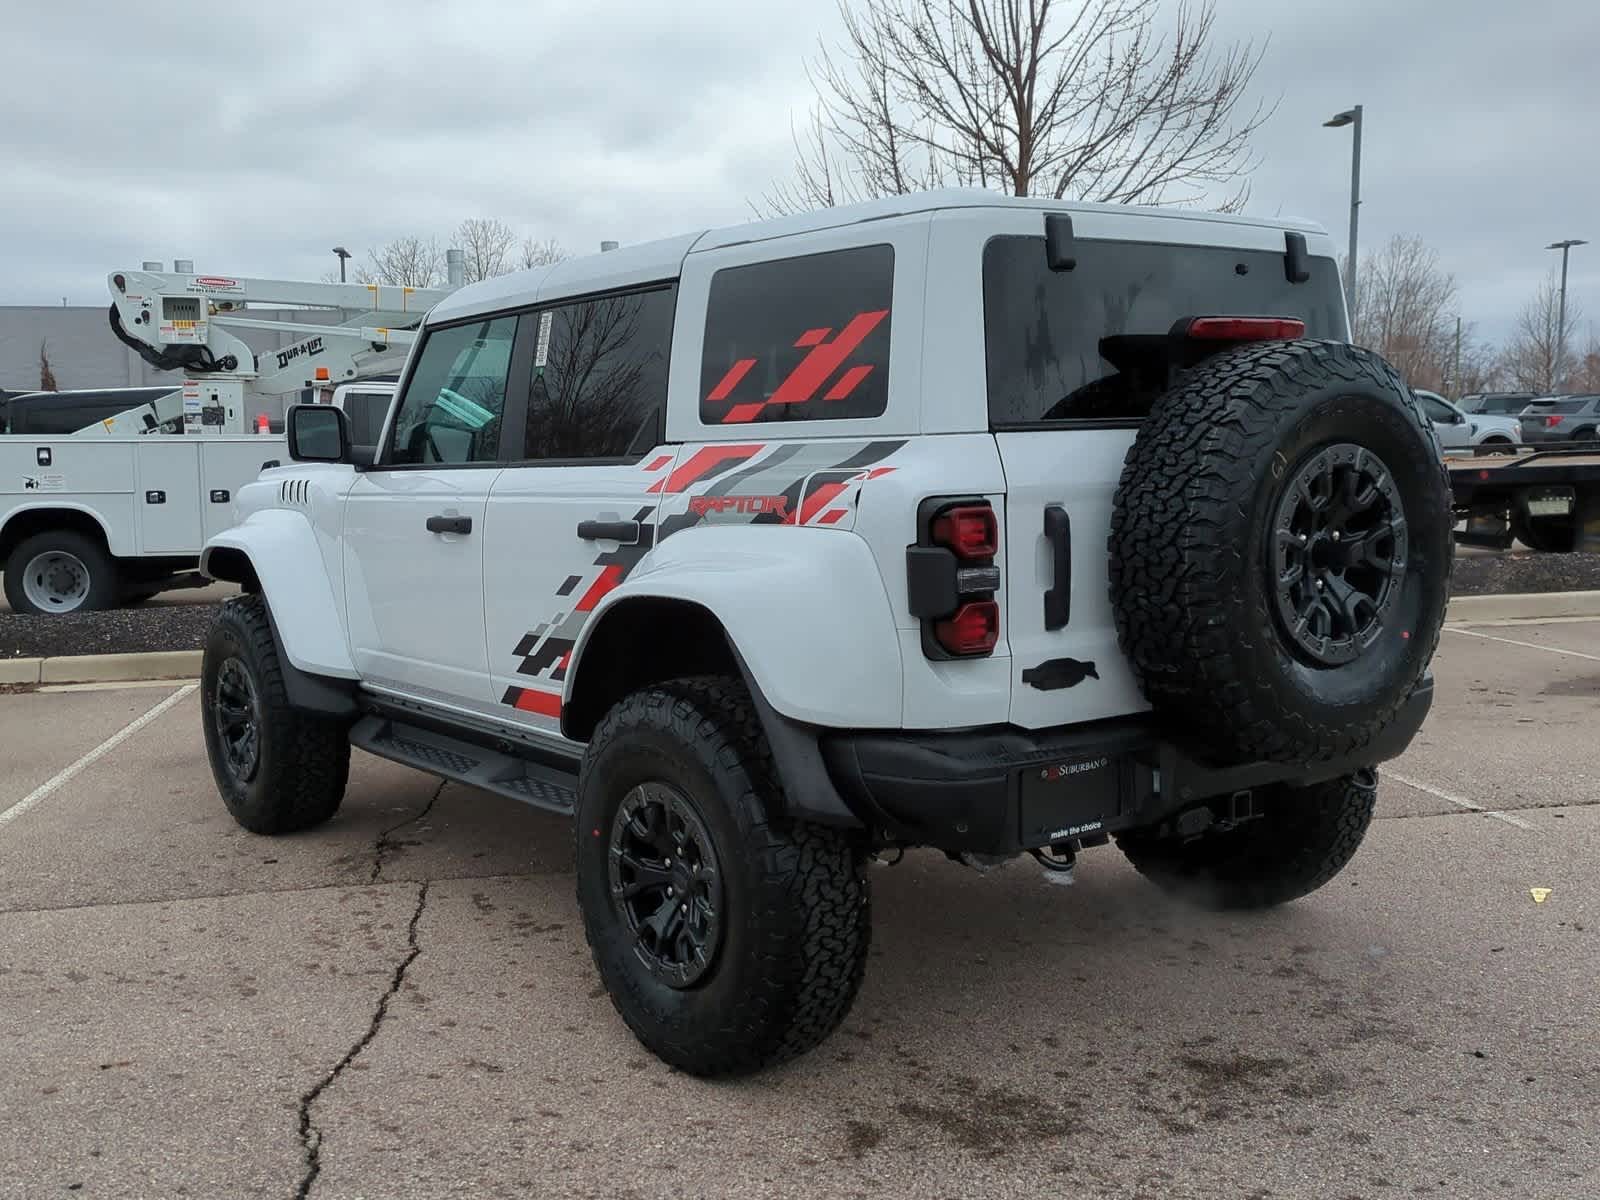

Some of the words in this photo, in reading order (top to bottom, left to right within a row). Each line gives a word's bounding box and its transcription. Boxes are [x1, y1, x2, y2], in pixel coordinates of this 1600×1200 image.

[688, 495, 788, 519] RAPTOR
[1050, 829, 1068, 839] make
[1069, 825, 1080, 835] the
[1081, 821, 1102, 832] choice
